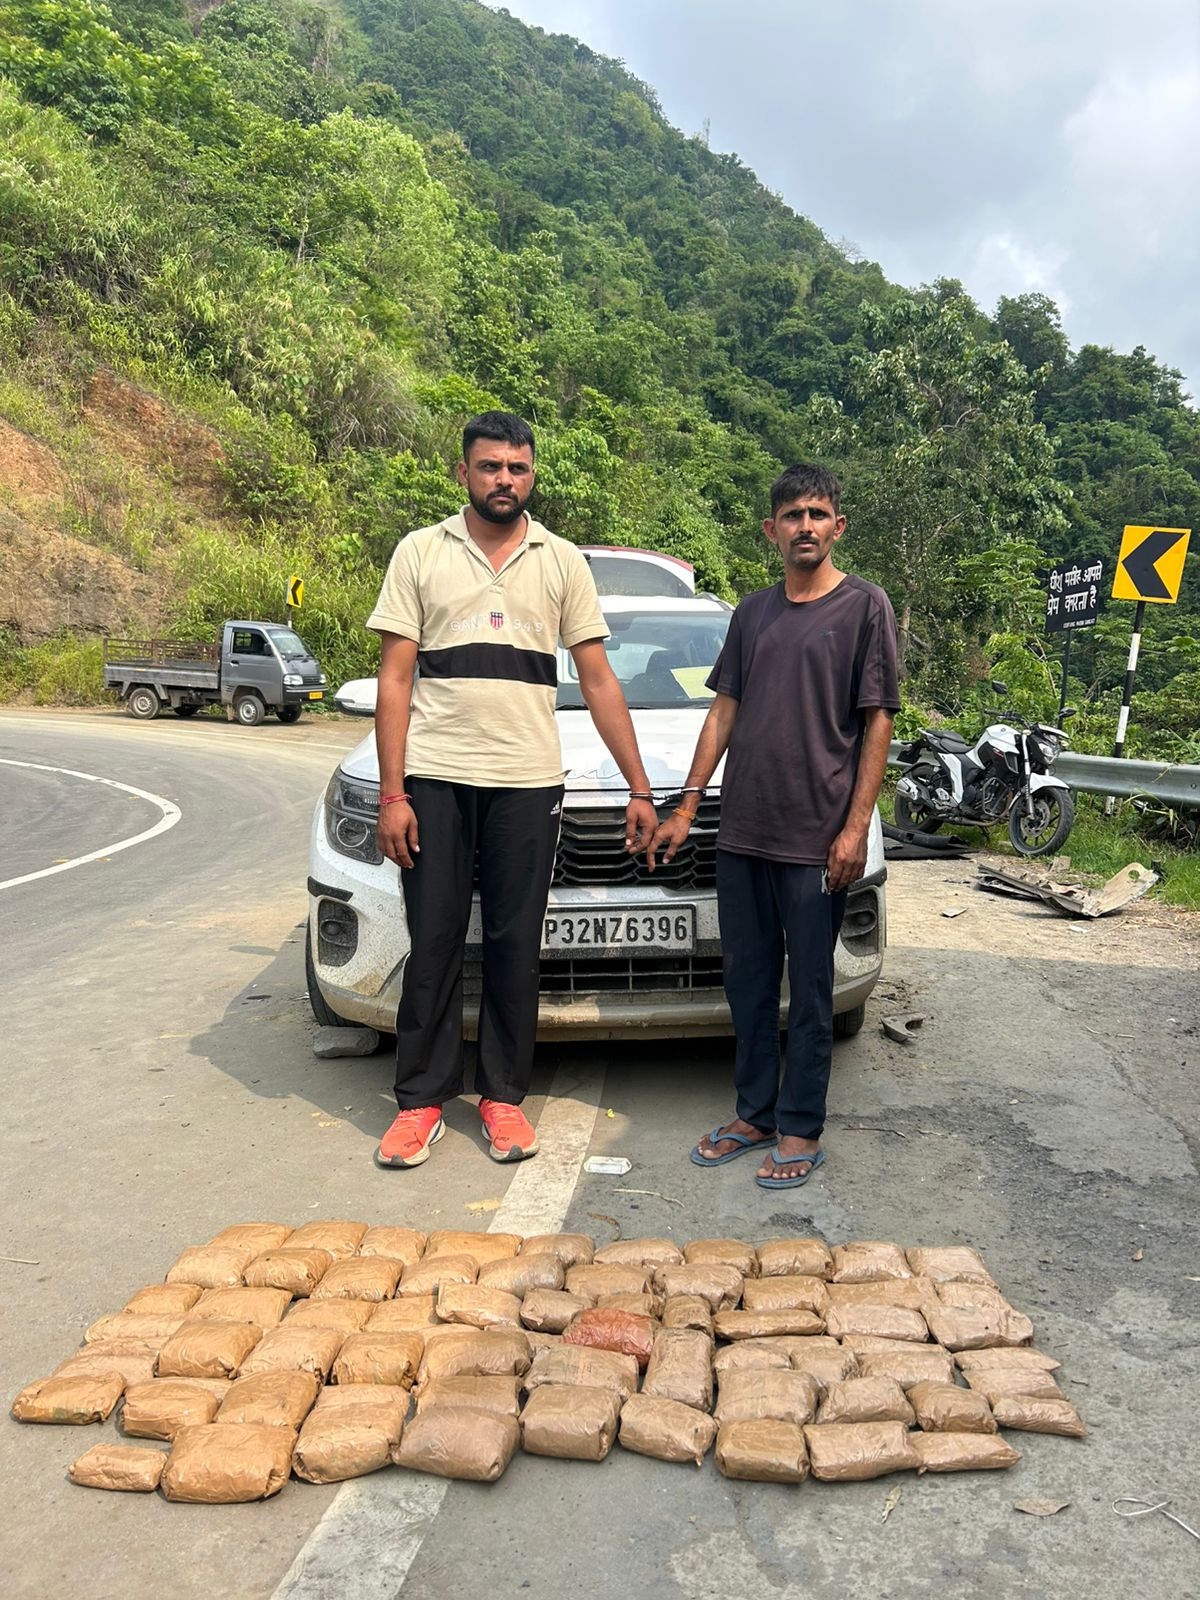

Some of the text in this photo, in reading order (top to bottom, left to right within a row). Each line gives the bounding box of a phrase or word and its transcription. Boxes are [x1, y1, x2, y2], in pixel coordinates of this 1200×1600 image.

[1047, 584, 1097, 616] प्रेम करता है
